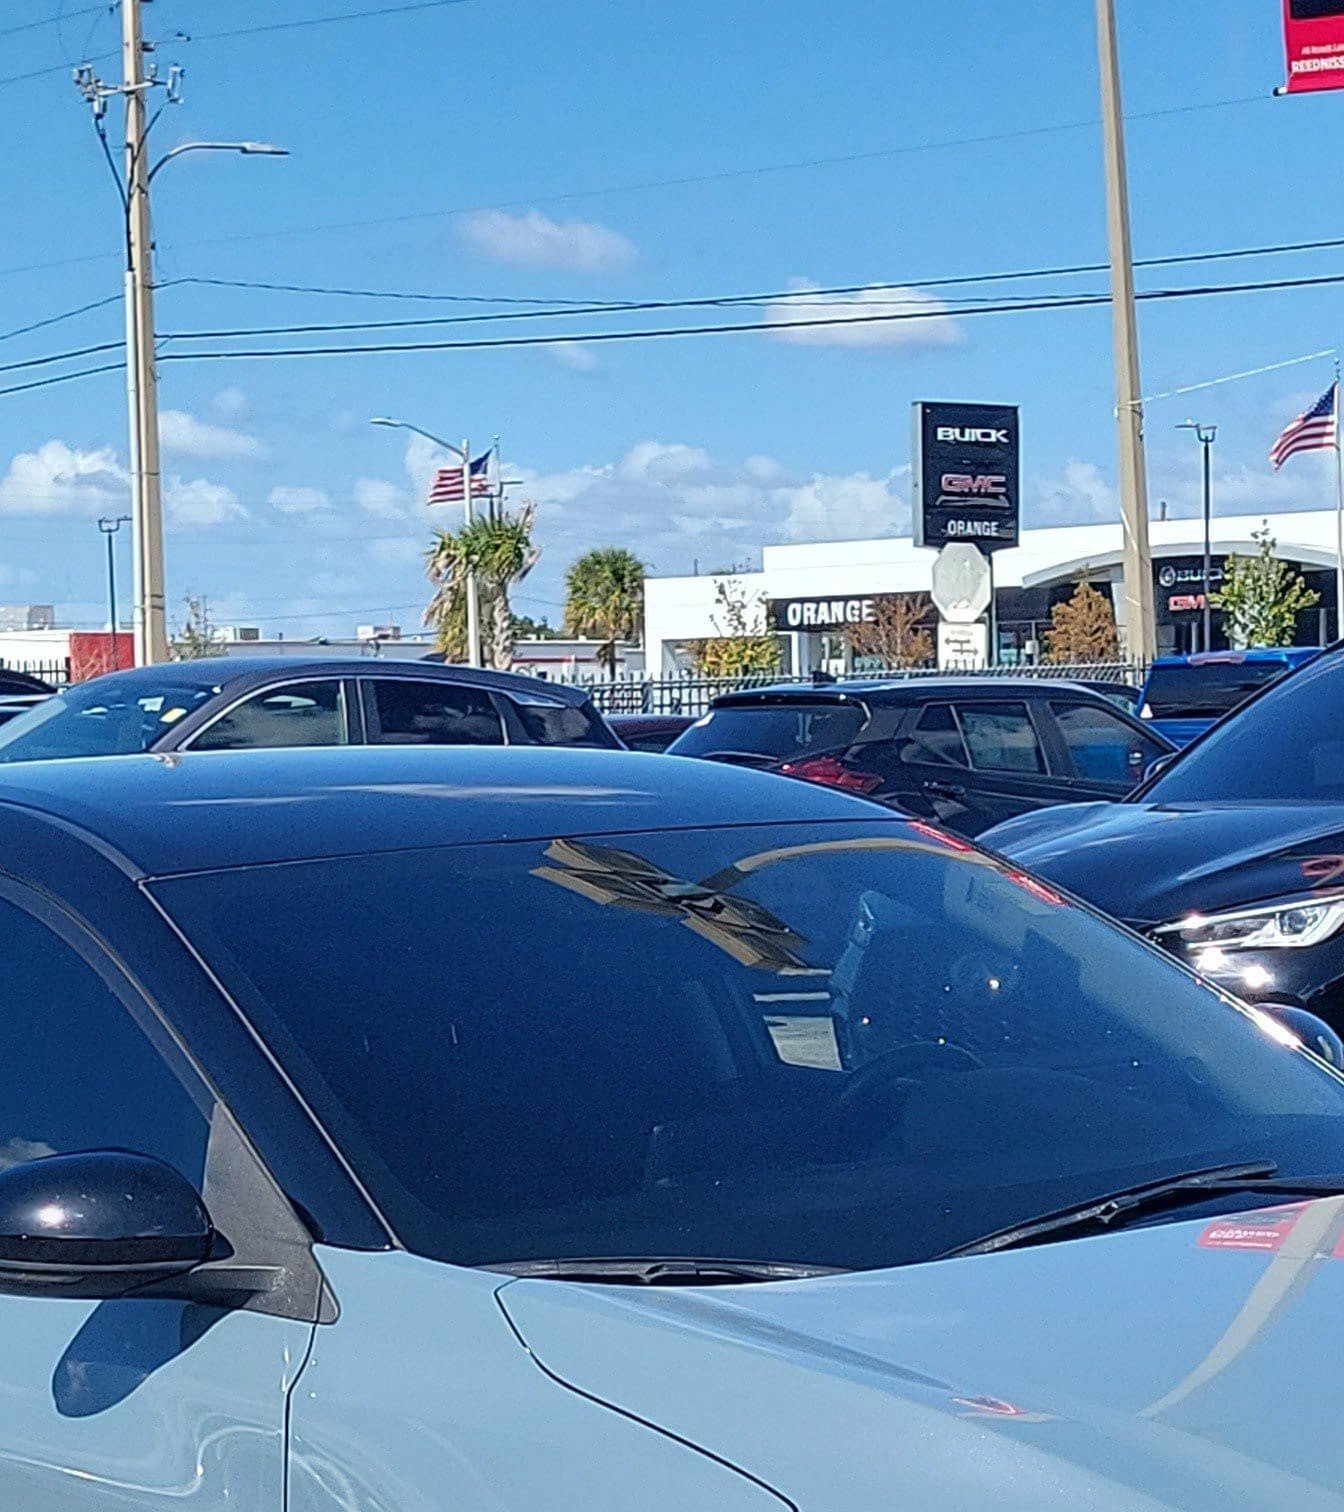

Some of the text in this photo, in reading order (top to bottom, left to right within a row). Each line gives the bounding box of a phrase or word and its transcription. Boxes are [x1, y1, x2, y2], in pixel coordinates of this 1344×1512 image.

[937, 427, 1009, 443] BUICK
[941, 473, 1006, 493] GMC
[947, 519, 999, 536] ORANGE
[787, 600, 877, 626] ORANGE
